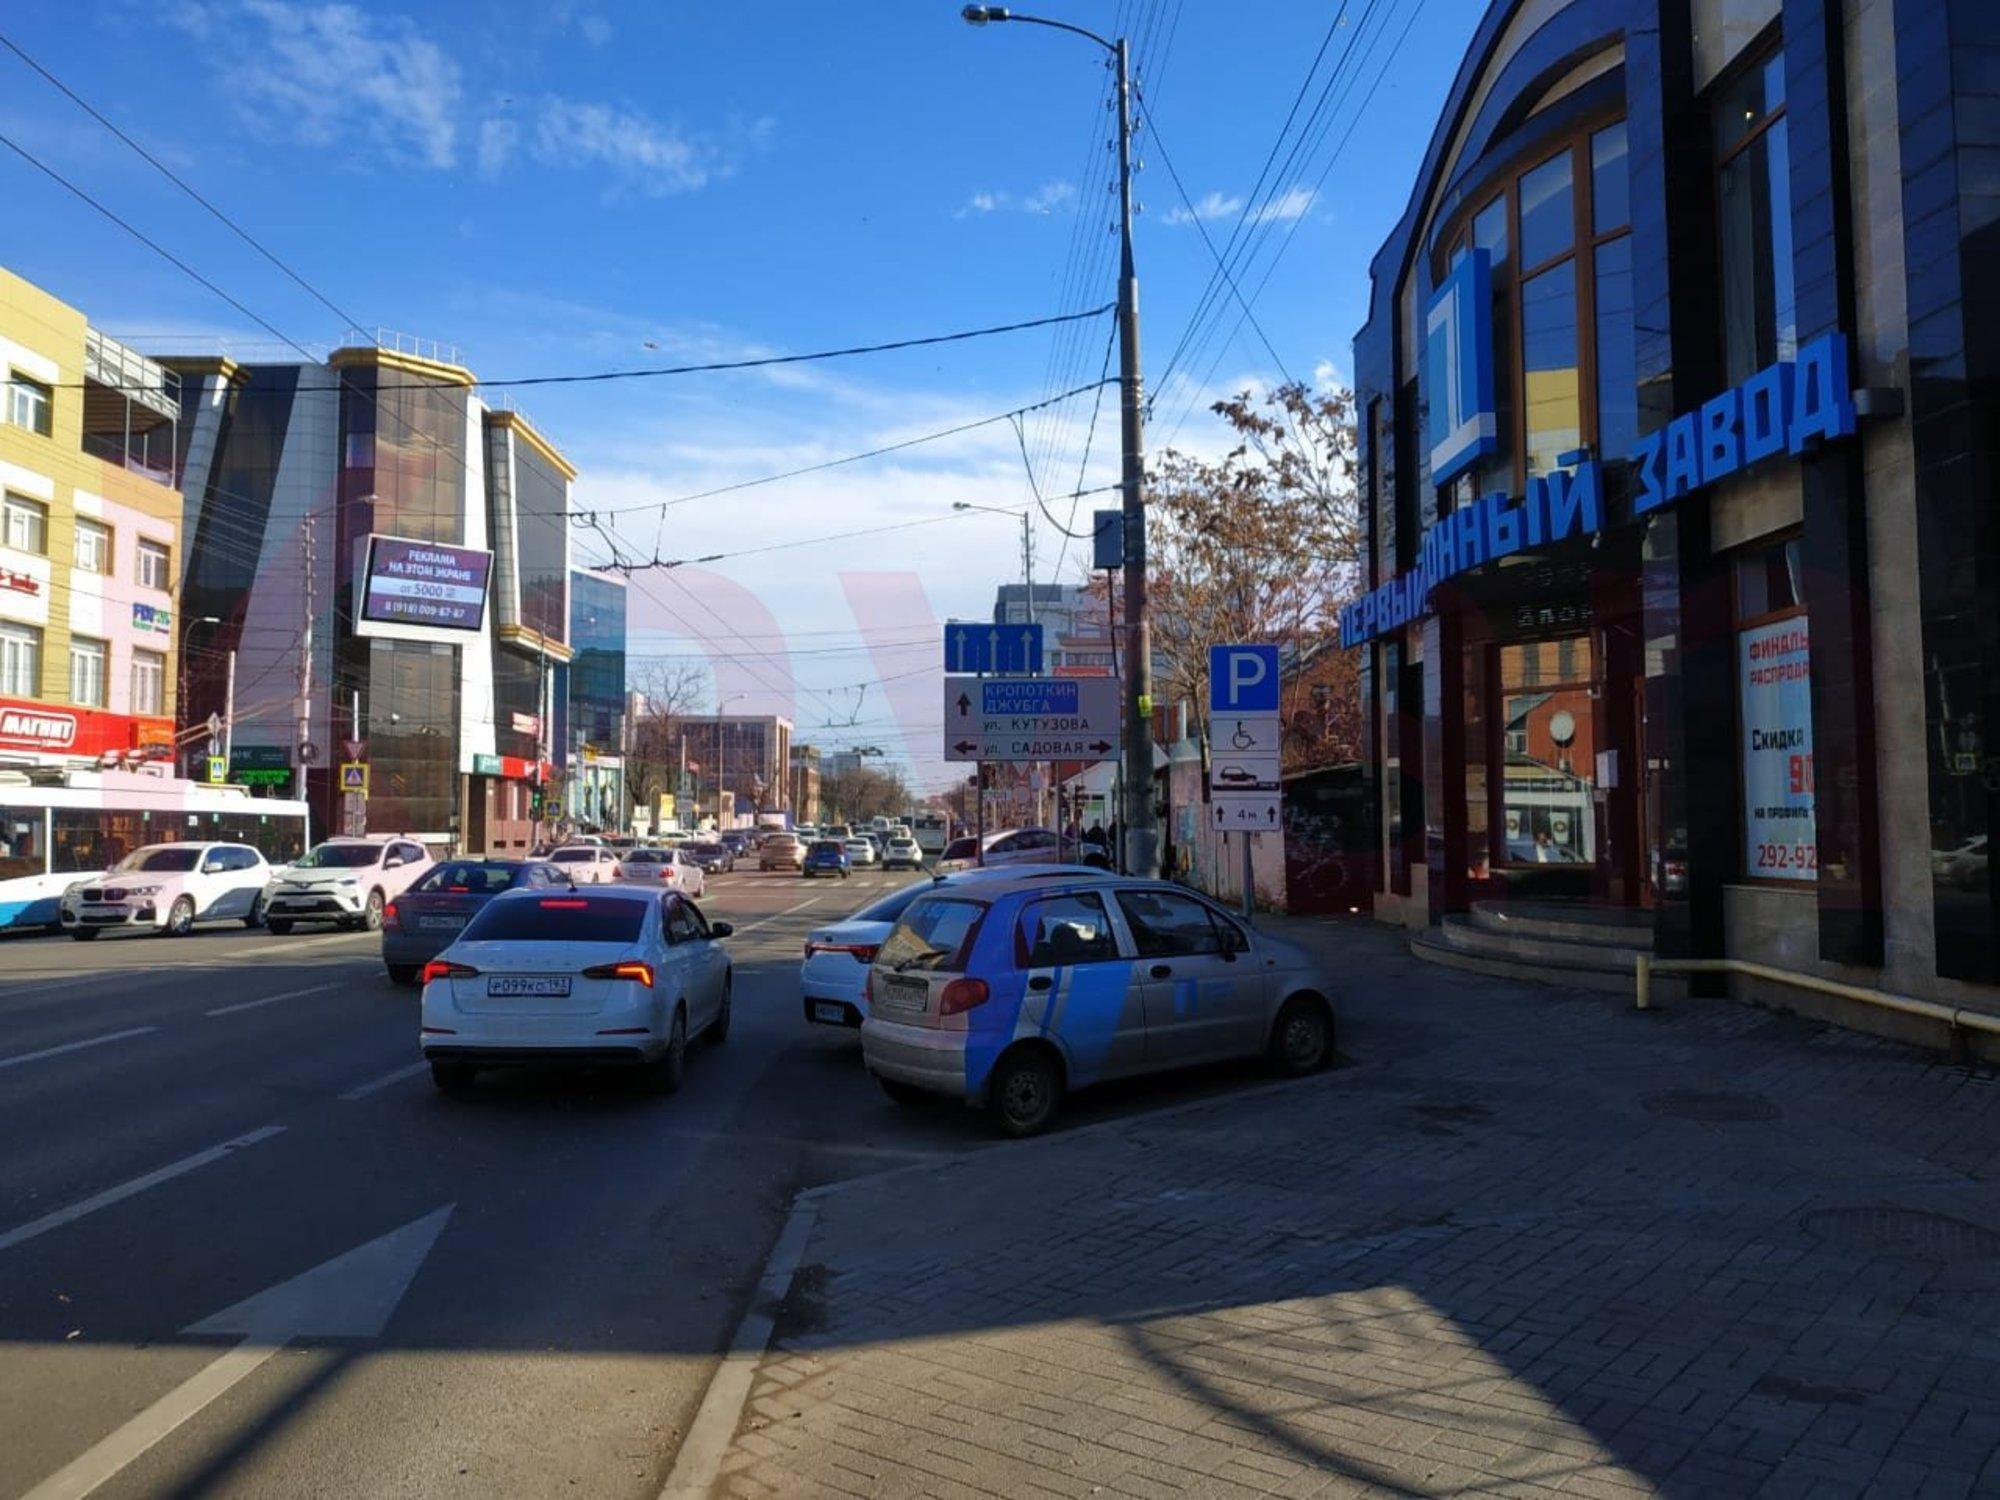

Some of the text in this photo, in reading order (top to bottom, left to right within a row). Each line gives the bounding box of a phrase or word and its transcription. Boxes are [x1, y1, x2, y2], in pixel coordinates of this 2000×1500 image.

[1631, 332, 1856, 514] ЗАВОД
[408, 549, 456, 566] РЕКЛАМА
[388, 562, 472, 581] НА ЭТОМ ЭКРАНЕ
[414, 584, 443, 598] 5000
[1229, 651, 1267, 705] P
[984, 684, 1076, 698] КРОПОТКИН
[984, 698, 1052, 713] ДЖУБГА
[983, 718, 1089, 732] ул. КУТУЗОВА
[984, 741, 1084, 756] ул. САДОВАЯ
